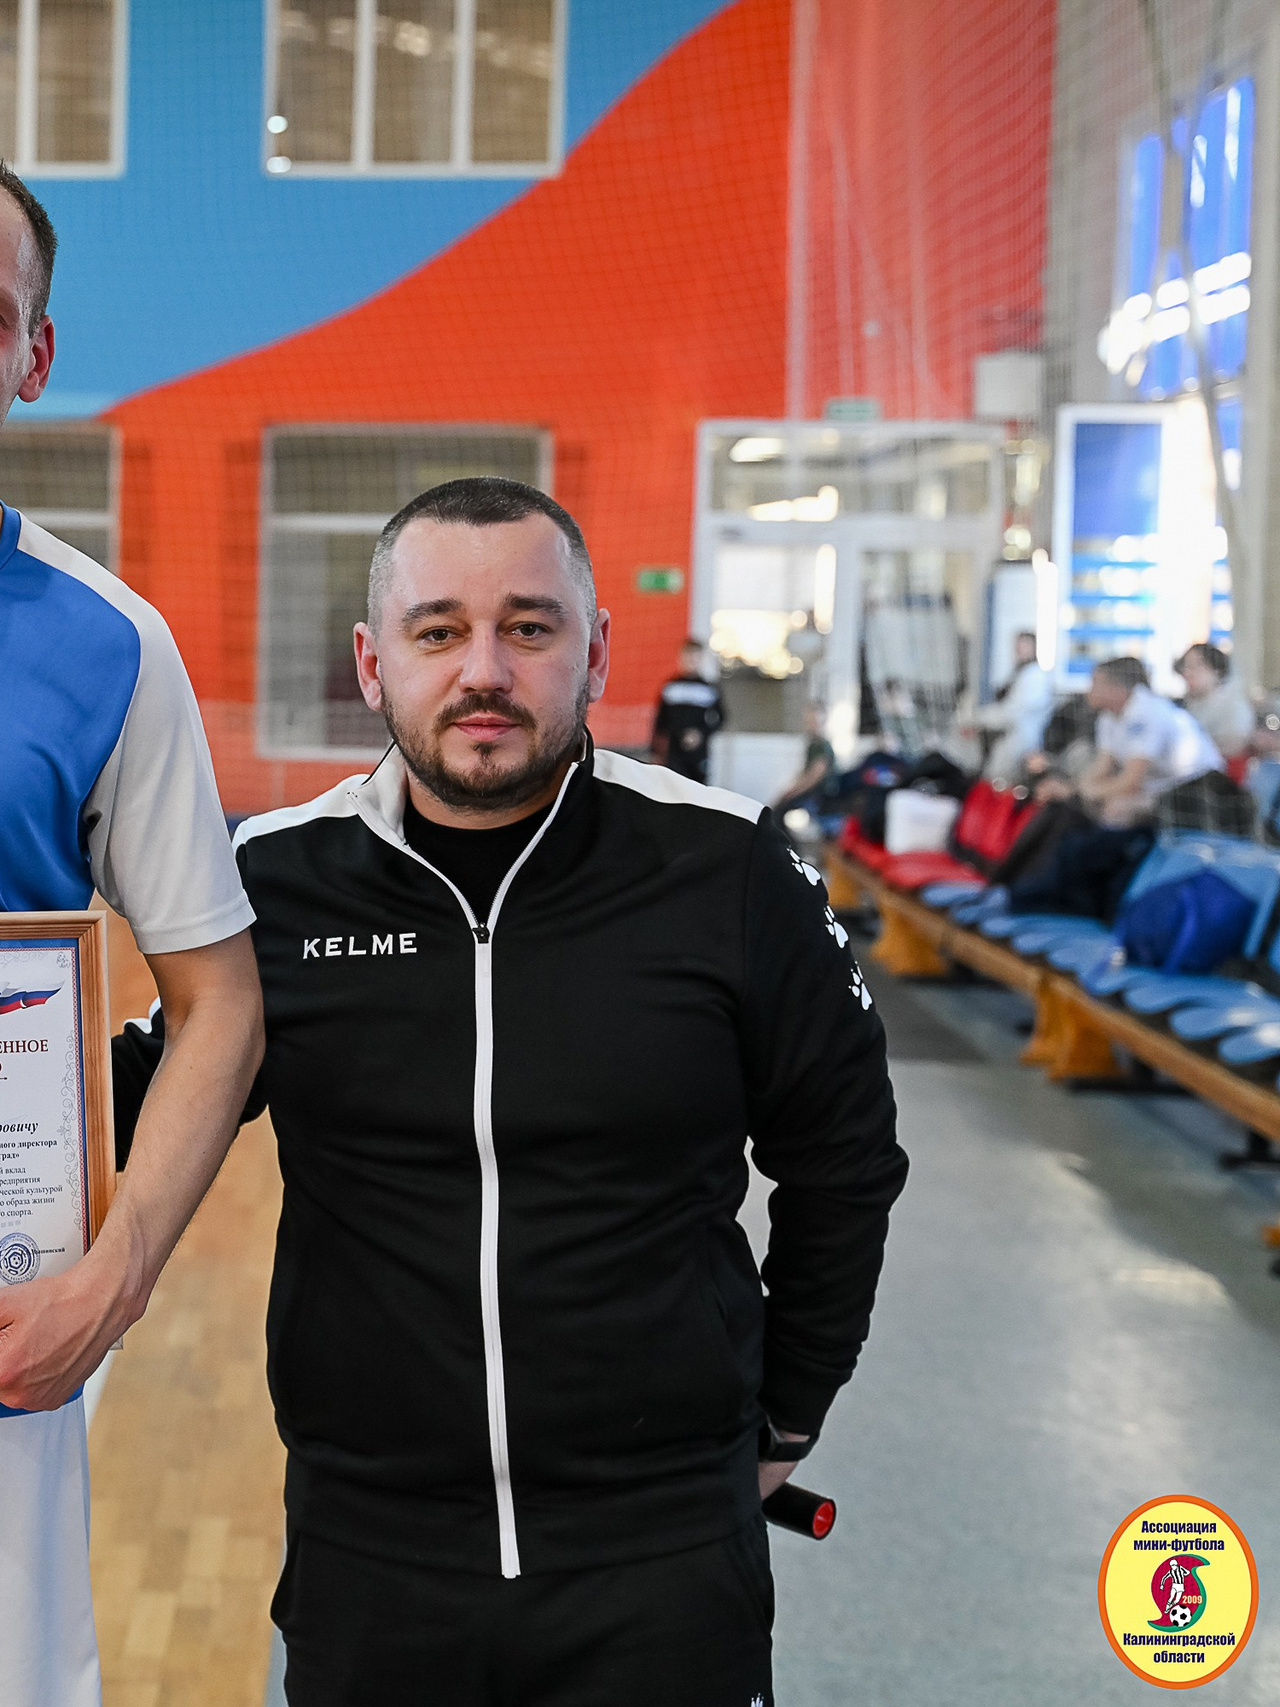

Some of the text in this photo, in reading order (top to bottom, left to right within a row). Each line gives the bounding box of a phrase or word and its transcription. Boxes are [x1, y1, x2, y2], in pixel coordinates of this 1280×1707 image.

[303, 932, 418, 959] KELME
[17, 1140, 58, 1150] директора
[4, 1167, 27, 1175] вклад
[25, 1184, 63, 1196] культурой
[5, 1197, 31, 1208] образа
[31, 1197, 55, 1205] жизни
[5, 1209, 34, 1219] спорта.
